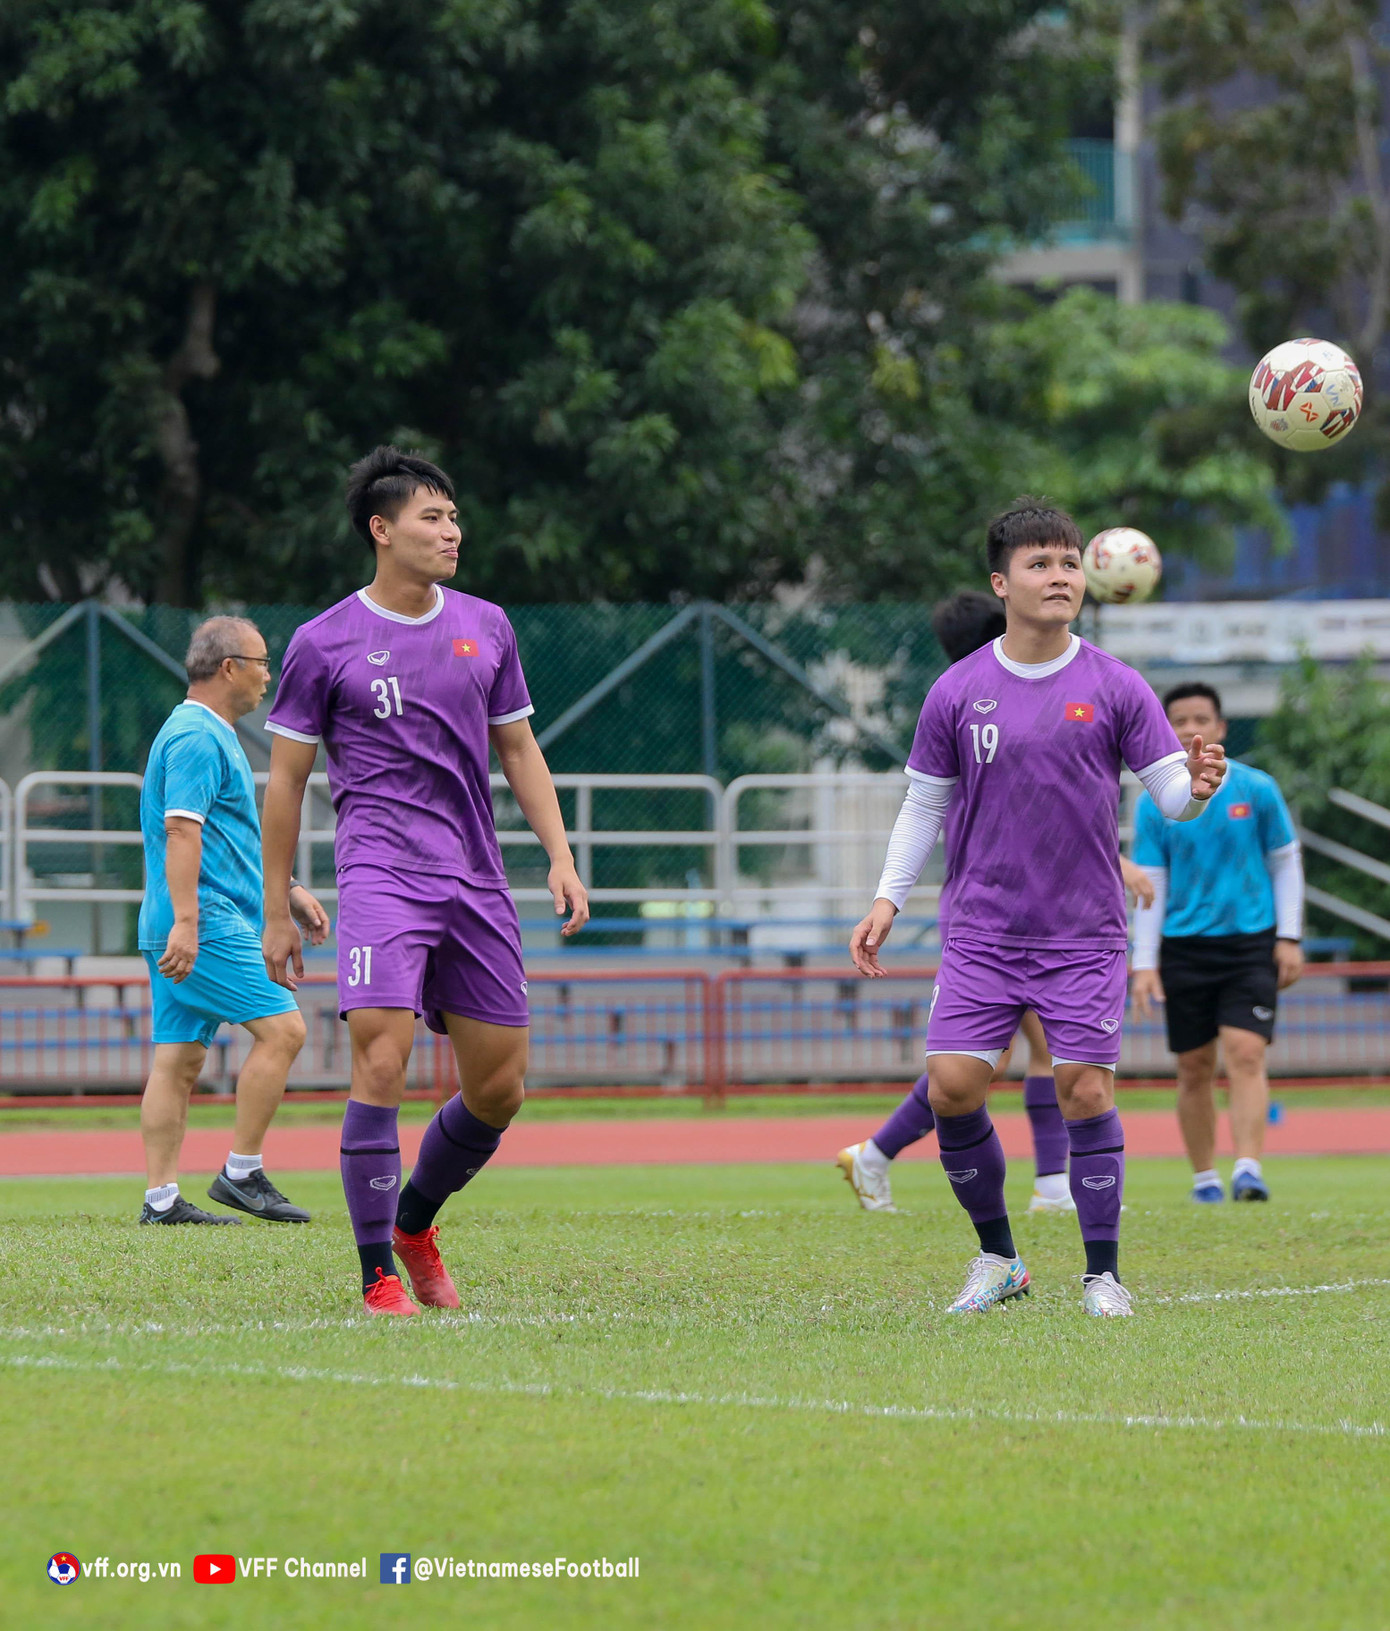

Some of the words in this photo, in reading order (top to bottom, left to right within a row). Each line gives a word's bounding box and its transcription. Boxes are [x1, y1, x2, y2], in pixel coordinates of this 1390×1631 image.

[369, 676, 403, 720] 31
[969, 723, 999, 764] 19
[347, 946, 372, 987] 31
